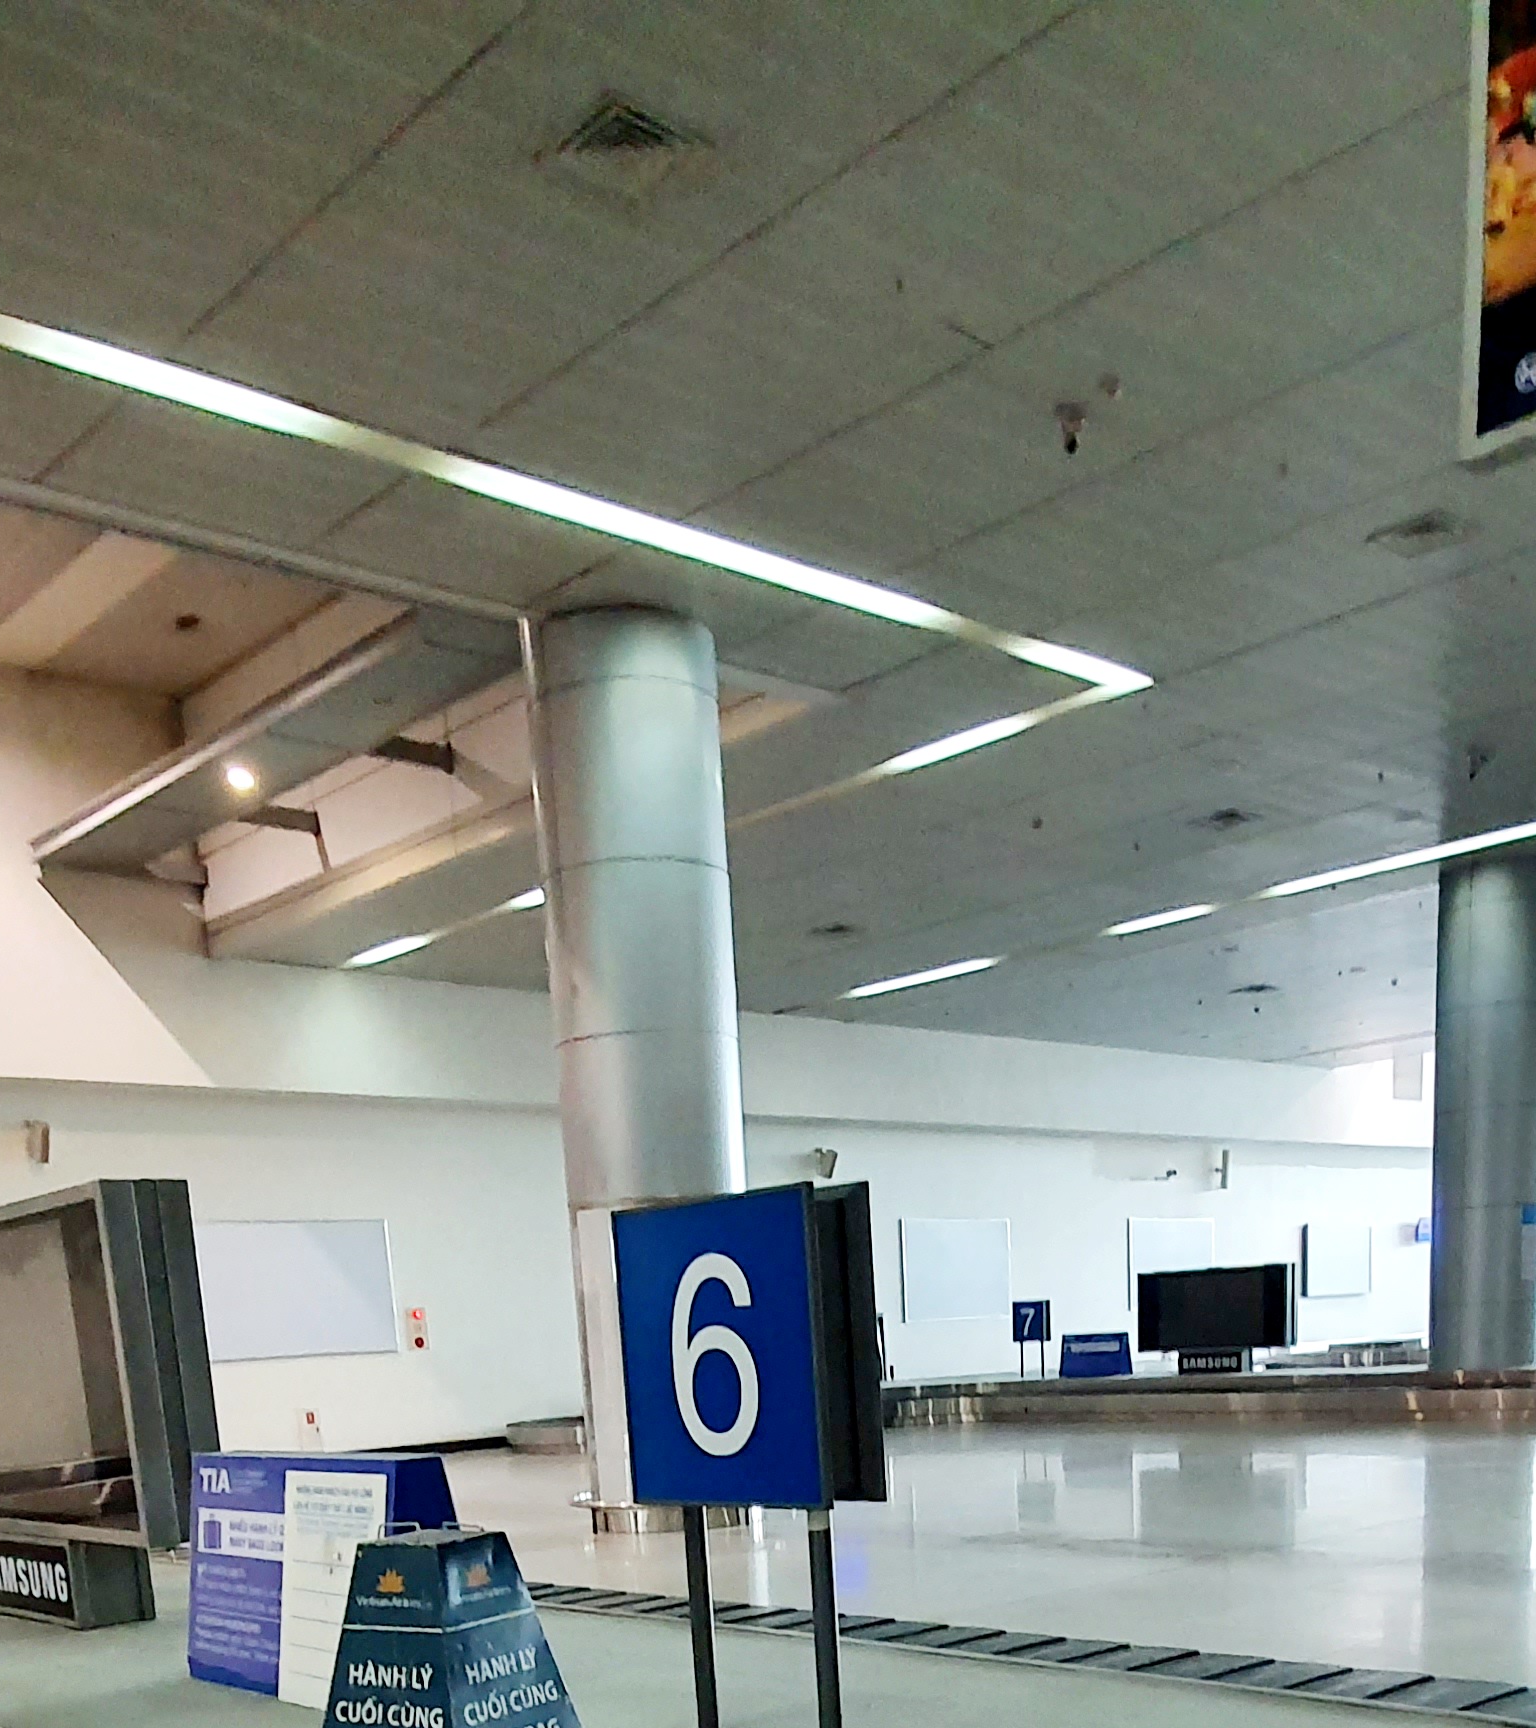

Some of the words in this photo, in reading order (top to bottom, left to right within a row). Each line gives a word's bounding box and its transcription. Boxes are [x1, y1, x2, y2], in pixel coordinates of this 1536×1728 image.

[1019, 1307, 1035, 1338] 7
[671, 1252, 759, 1457] 6
[1182, 1356, 1238, 1370] SAMSUNG
[199, 1467, 231, 1494] TIA
[348, 1659, 407, 1689] HÀNH
[411, 1662, 434, 1691] LÝ
[335, 1695, 384, 1726] CUỐI
[464, 1688, 509, 1727] CUỐI
[510, 1679, 558, 1712] CÙNG
